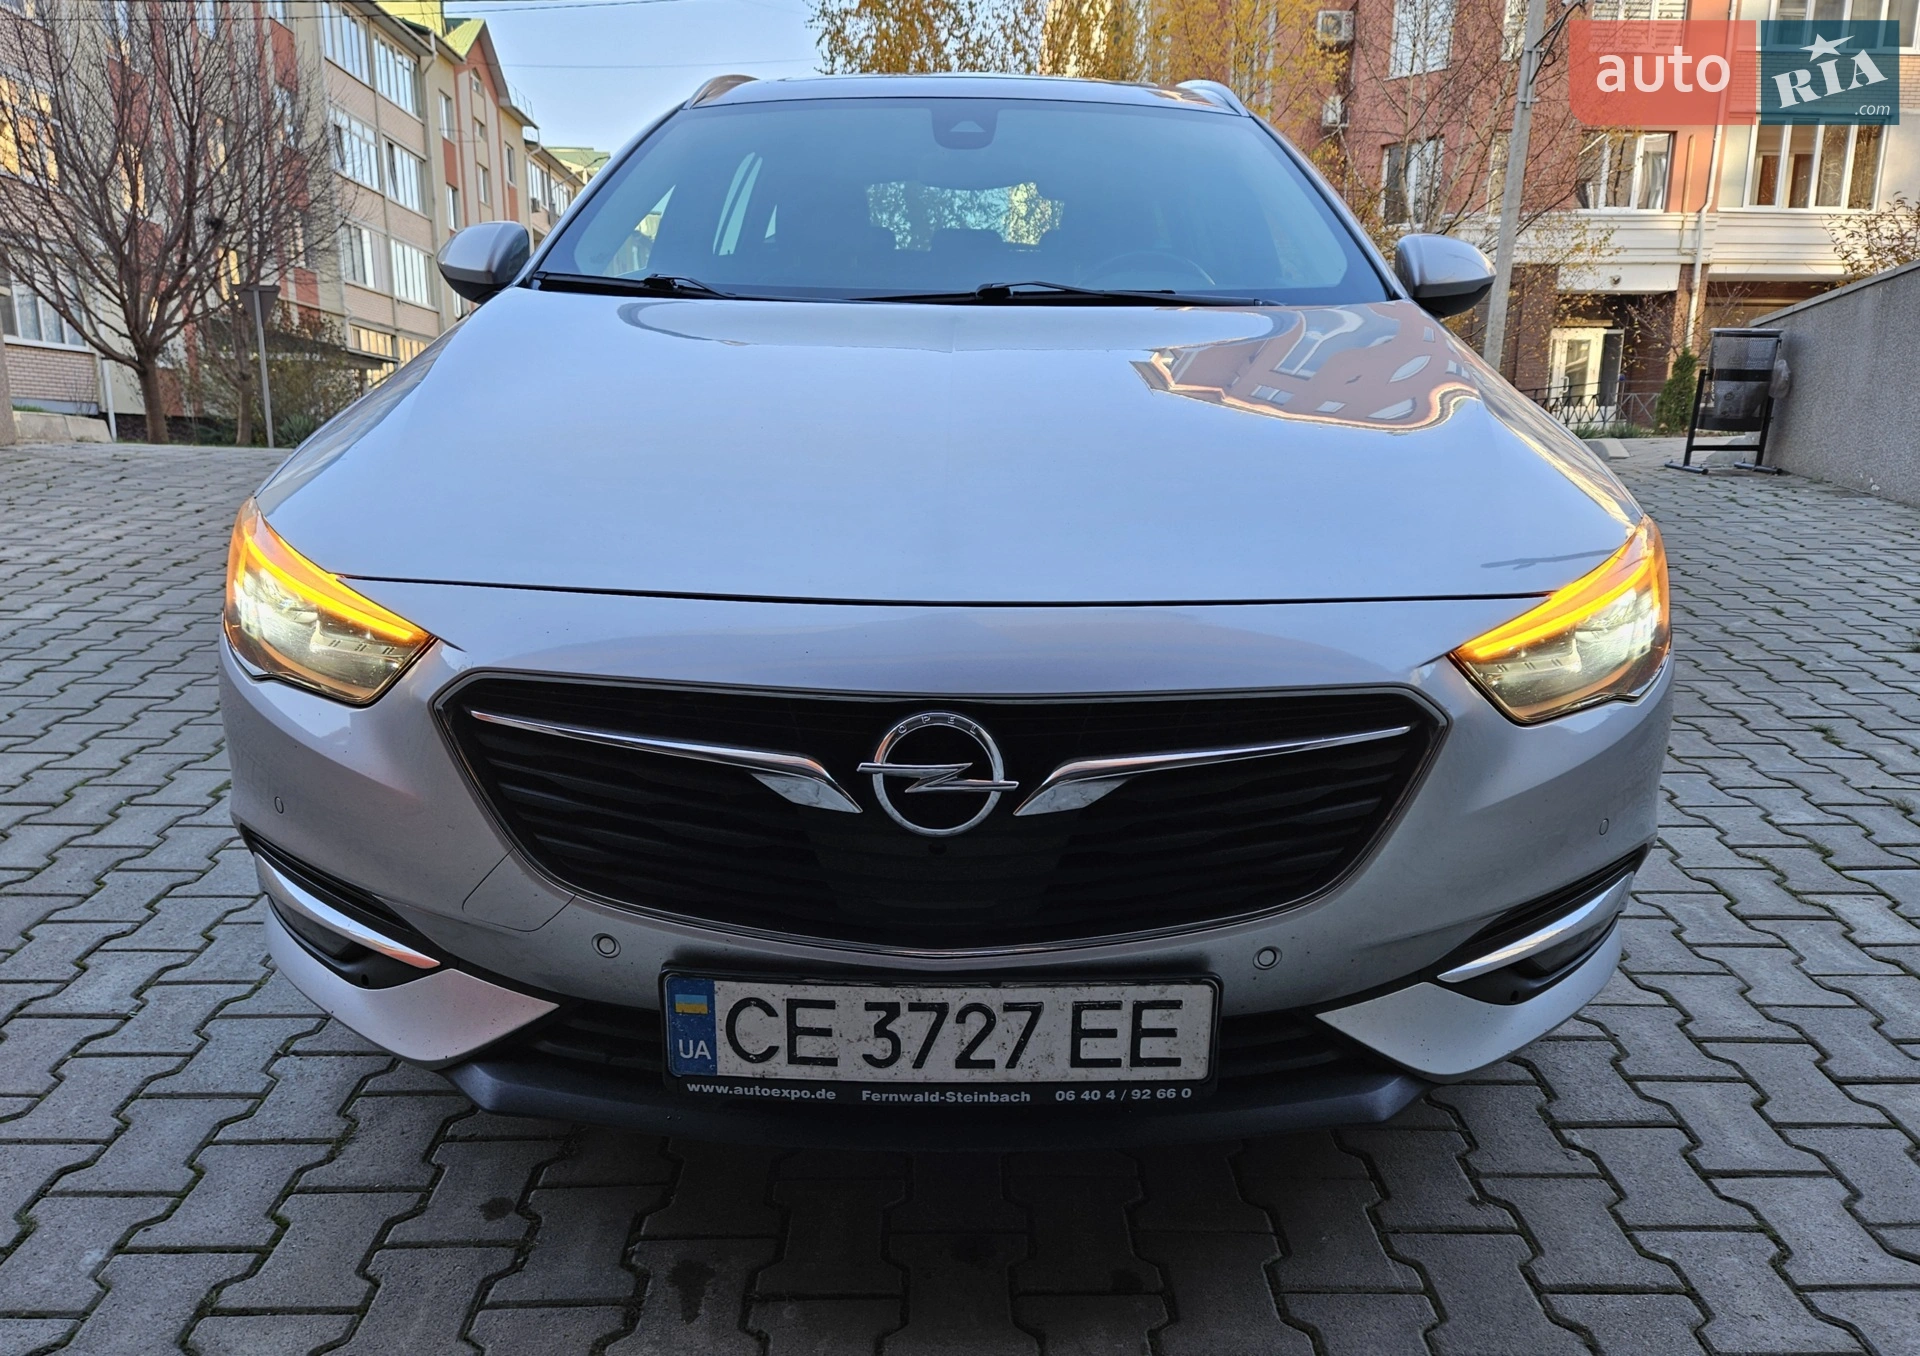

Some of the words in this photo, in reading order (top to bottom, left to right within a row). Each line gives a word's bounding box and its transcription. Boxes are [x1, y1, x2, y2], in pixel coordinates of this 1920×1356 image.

[897, 715, 978, 735] OPEL
[725, 996, 838, 1067] CE
[861, 1001, 1044, 1070] 3727
[1070, 999, 1184, 1068] EE
[678, 1039, 711, 1060] UA
[686, 1081, 836, 1100] www.autoexpo.de
[861, 1090, 1031, 1103] Fernwald-Steinbach
[1055, 1090, 1076, 1101] 06
[1080, 1090, 1101, 1101] 40
[1105, 1090, 1116, 1100] 4
[1131, 1089, 1151, 1100] 92
[1156, 1088, 1176, 1099] 66
[1181, 1088, 1192, 1099] 0
